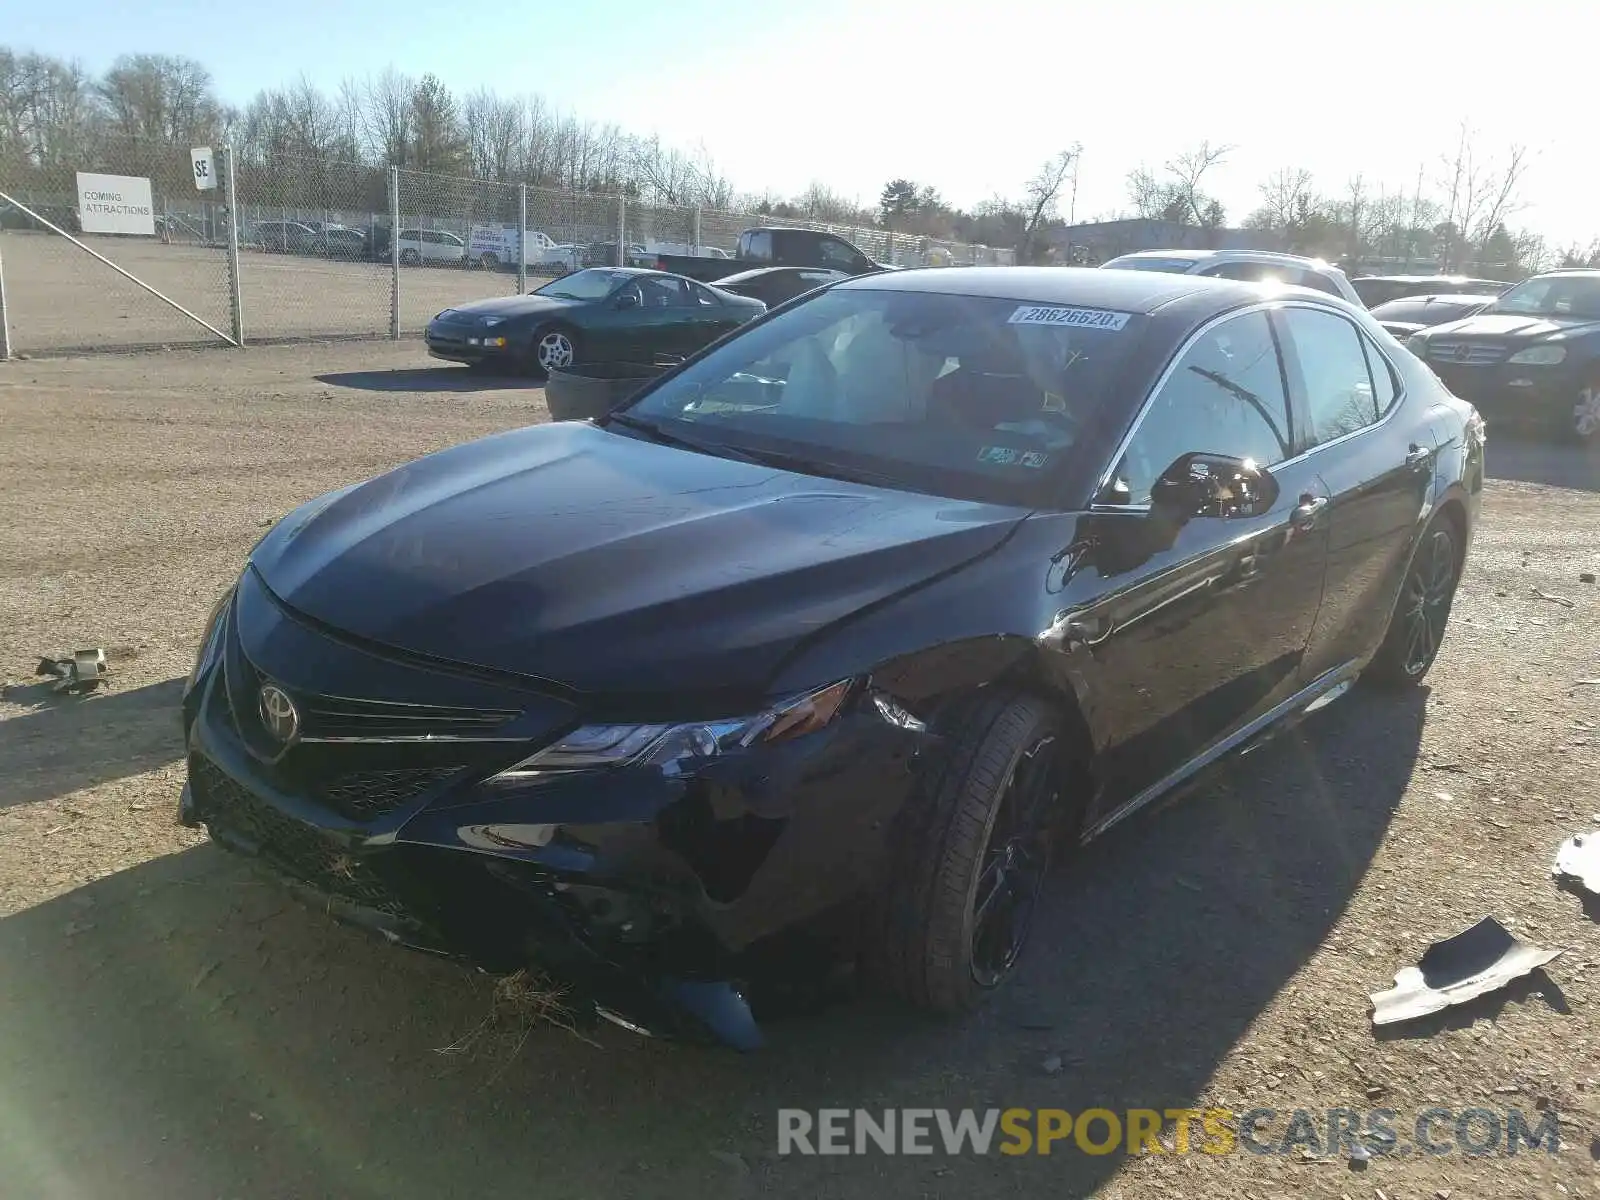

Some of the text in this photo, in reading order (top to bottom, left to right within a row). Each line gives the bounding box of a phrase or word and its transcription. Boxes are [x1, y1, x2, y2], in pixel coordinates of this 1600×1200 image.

[195, 160, 208, 177] SE
[84, 192, 122, 202] COMING
[85, 203, 149, 216] ATTRACTIONS
